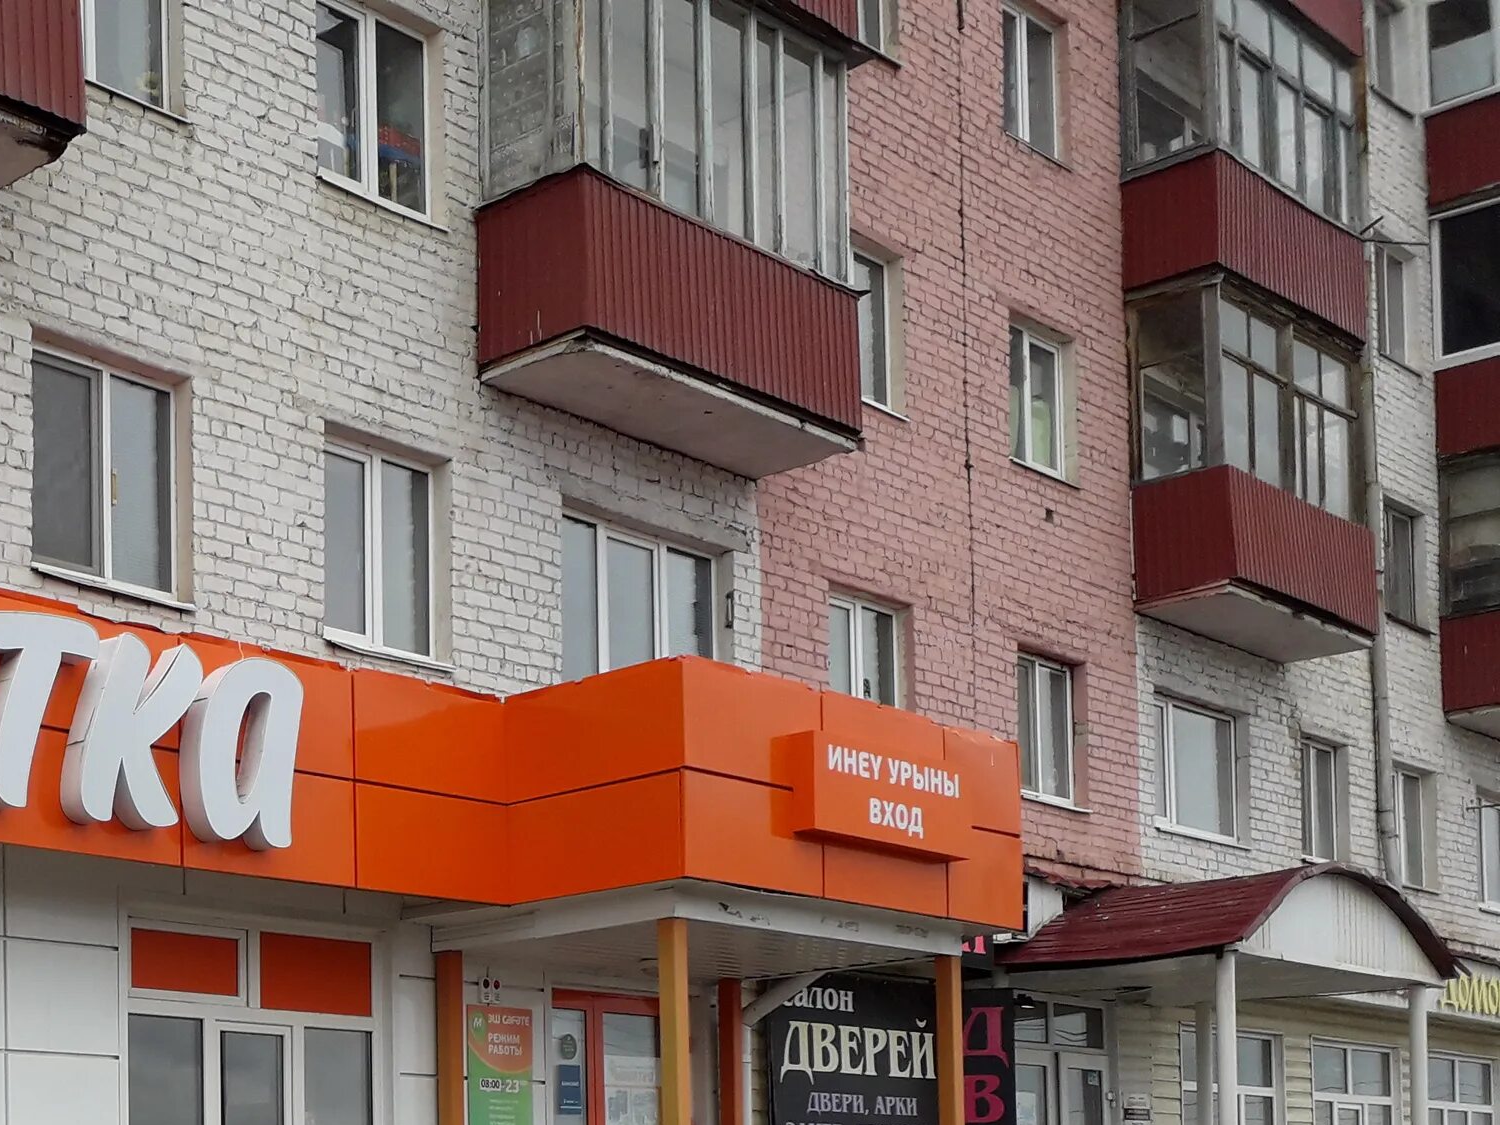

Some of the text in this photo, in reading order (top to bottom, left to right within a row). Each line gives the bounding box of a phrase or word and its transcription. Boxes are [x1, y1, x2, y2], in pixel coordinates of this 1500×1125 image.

[888, 757, 960, 799] УРЫНЫ
[868, 798, 924, 839] ВХОД
[487, 1032, 520, 1045] РЕЖИМ
[487, 1044, 523, 1057] РАБОТЫ
[780, 1017, 937, 1086] ДВЕРЕЙ
[806, 1091, 918, 1116] ДВЕРИ, АРКИ
